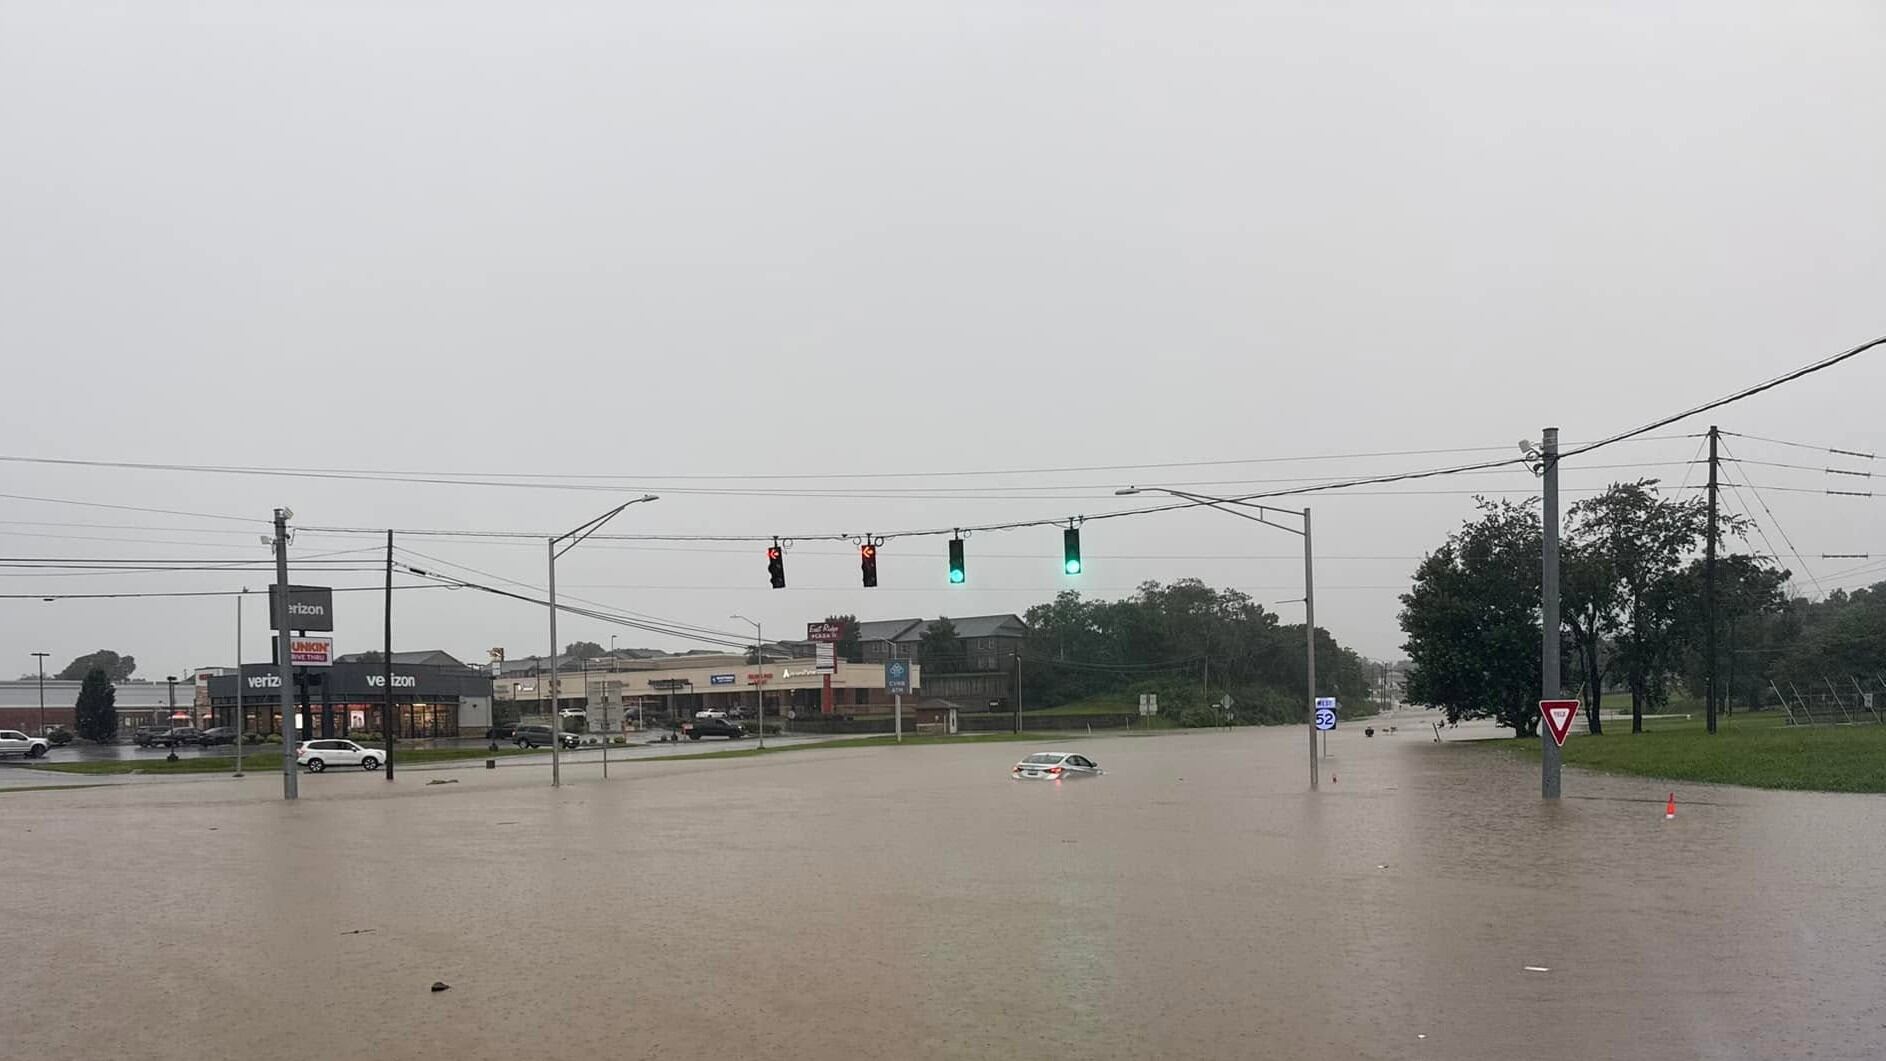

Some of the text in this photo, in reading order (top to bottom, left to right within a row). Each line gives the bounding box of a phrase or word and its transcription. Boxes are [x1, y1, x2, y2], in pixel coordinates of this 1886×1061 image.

[288, 603, 324, 615] erizon
[292, 641, 329, 652] UNKIN'
[248, 673, 281, 688] veriz
[367, 673, 415, 687] veizon
[1316, 713, 1333, 725] 52
